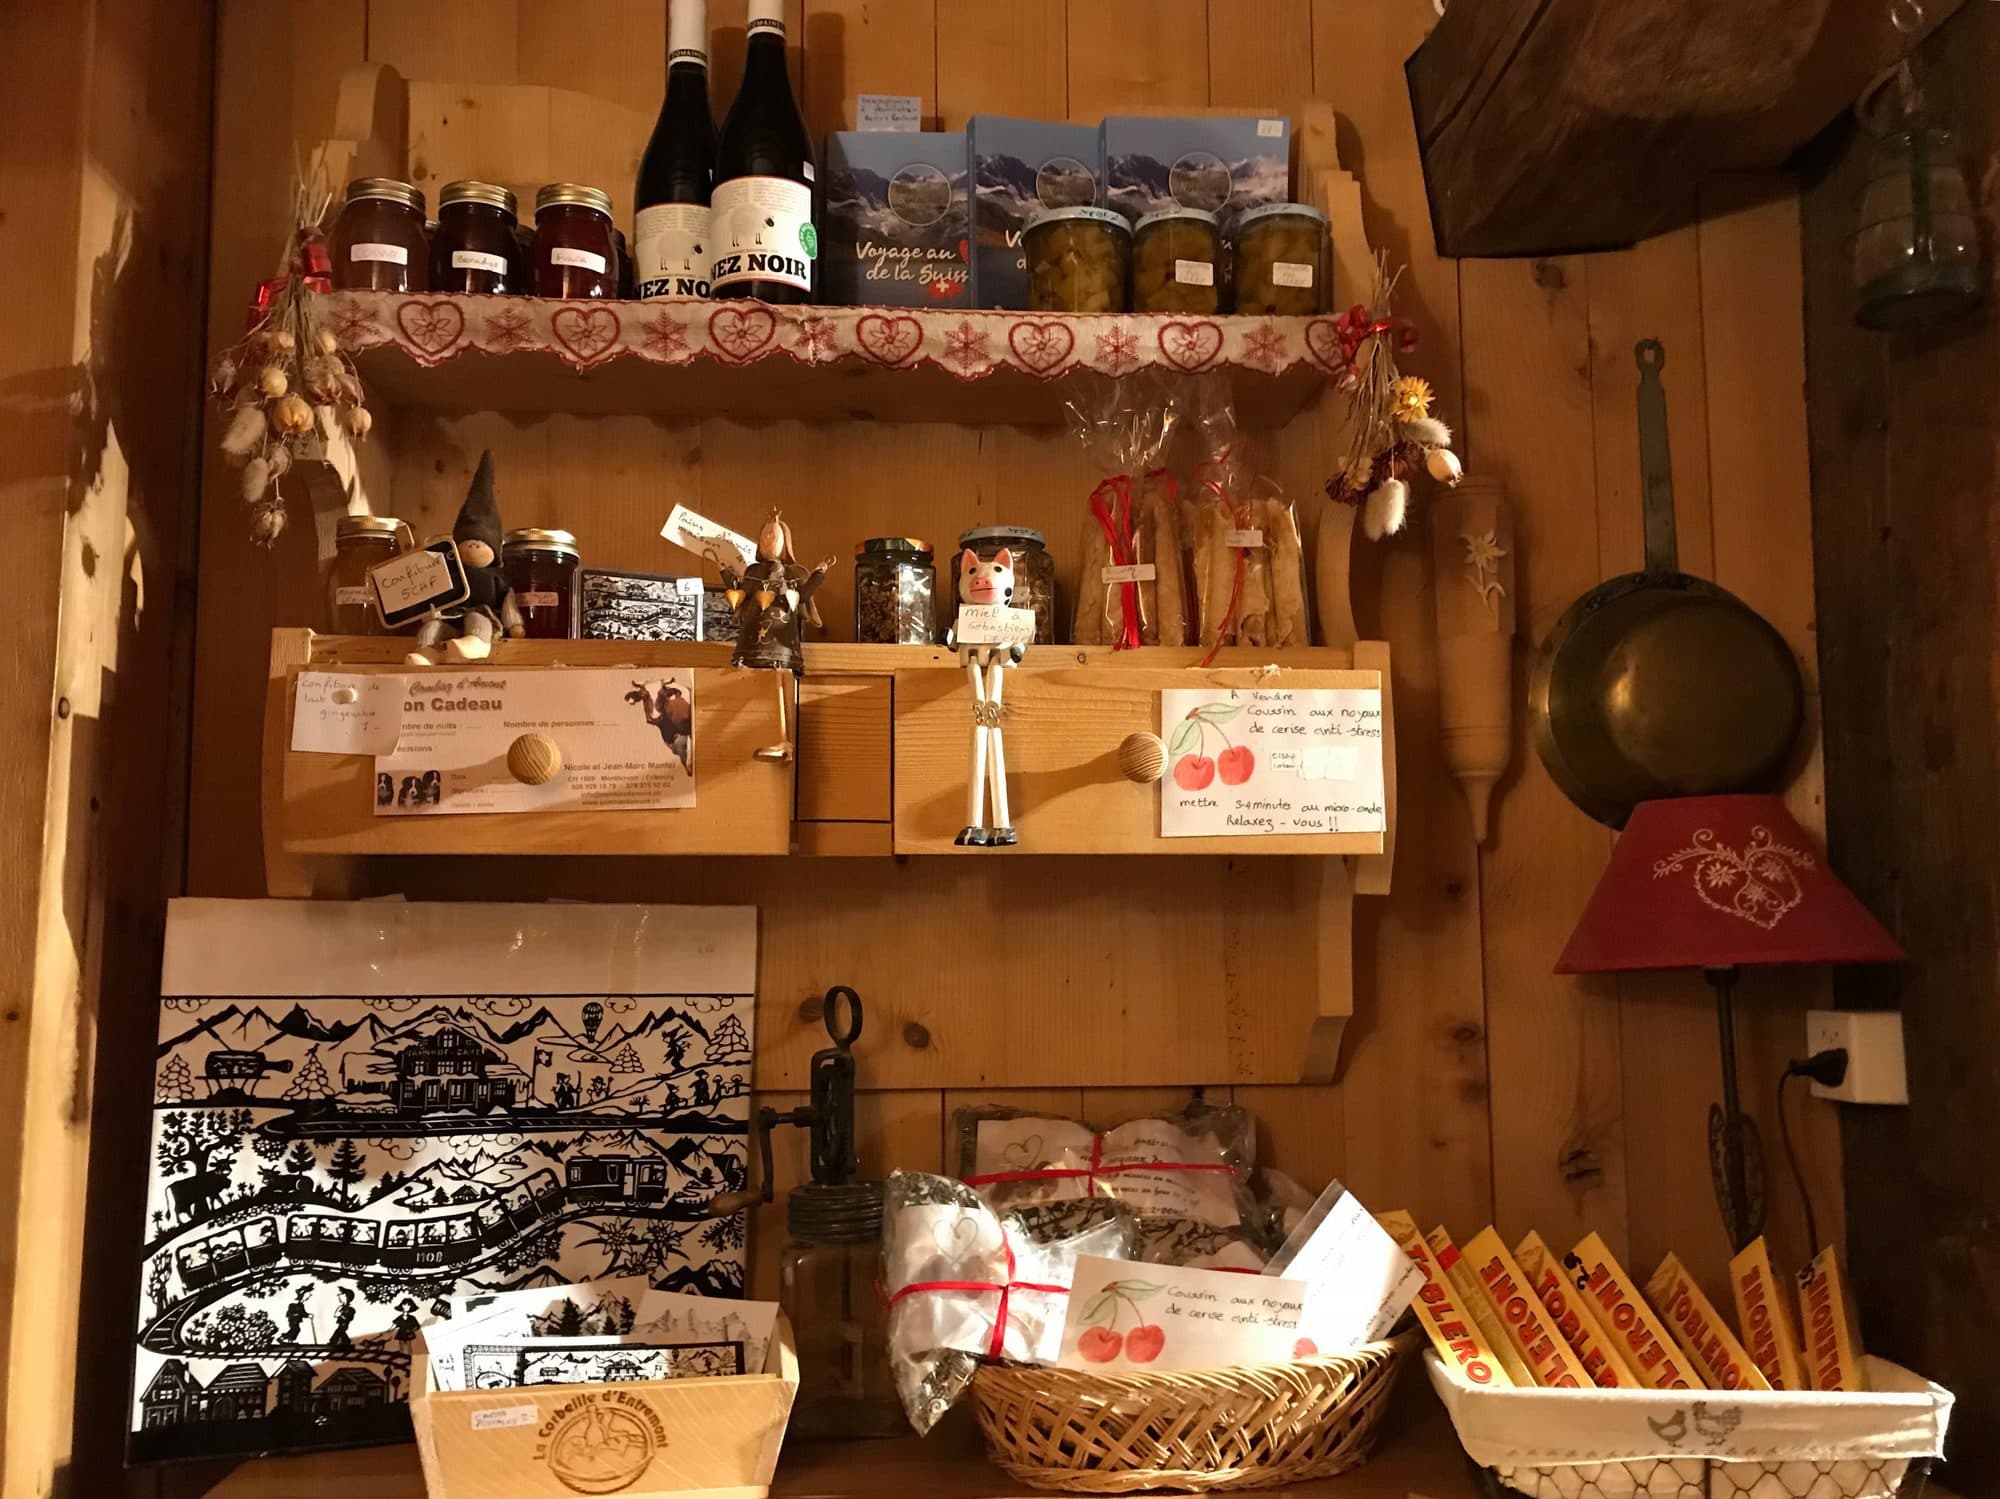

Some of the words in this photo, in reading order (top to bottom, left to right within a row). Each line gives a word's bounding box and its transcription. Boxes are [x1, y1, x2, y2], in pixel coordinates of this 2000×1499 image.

[856, 241, 923, 268] Voyage
[926, 248, 956, 259] au
[748, 254, 807, 280] NOIR
[866, 266, 891, 280] de
[894, 266, 915, 280] la
[430, 697, 502, 711] Cadeau
[1247, 705, 1297, 716] Coussin
[1309, 709, 1334, 718] aux
[423, 722, 434, 730] de
[436, 721, 457, 730] nuits
[503, 721, 537, 729] Nombre
[538, 721, 549, 729] de
[551, 720, 595, 729] personnes
[1249, 721, 1264, 735] de
[1272, 724, 1306, 735] cerise
[564, 763, 590, 771] Nicole
[592, 763, 600, 771] et
[603, 762, 646, 770] Jean-Marc
[1180, 799, 1219, 808] mettre
[1301, 803, 1319, 813] au
[1227, 815, 1274, 832] Relaxez
[1293, 818, 1323, 828] vous
[416, 1251, 443, 1263] MOB
[1167, 1287, 1217, 1301] Coussin
[1230, 1296, 1255, 1305] aux
[1165, 1303, 1182, 1315] de
[1188, 1309, 1224, 1321] cerise
[538, 1393, 596, 1438] Corbeille
[601, 1389, 669, 1449] d'Entremont
[532, 1443, 547, 1461] La
